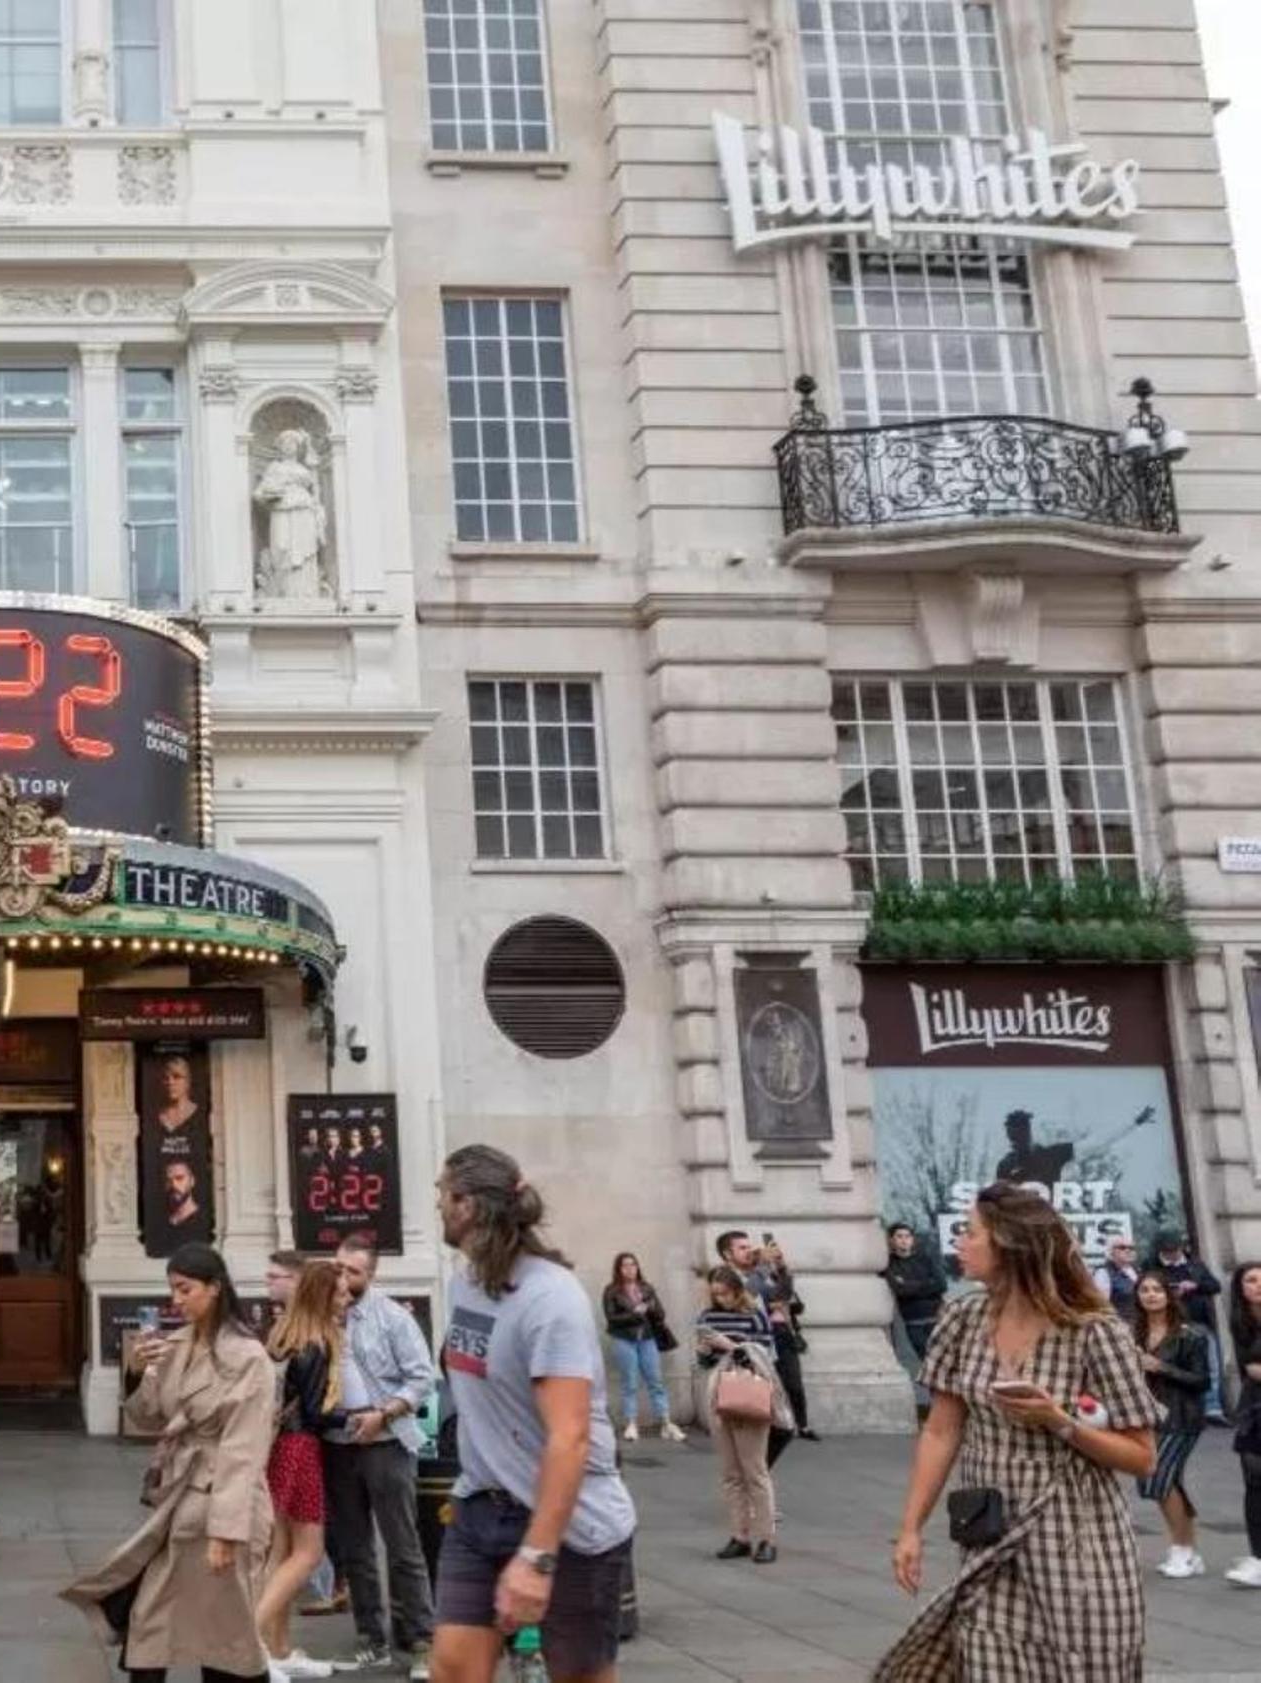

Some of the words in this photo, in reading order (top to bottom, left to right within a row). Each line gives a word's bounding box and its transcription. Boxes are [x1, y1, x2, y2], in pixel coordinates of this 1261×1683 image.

[712, 112, 1139, 250] Lillywhites
[18, 777, 71, 796] TORY
[127, 865, 265, 917] THEATRE
[909, 982, 1111, 1054] Lillywhites
[309, 1174, 382, 1212] 2:22
